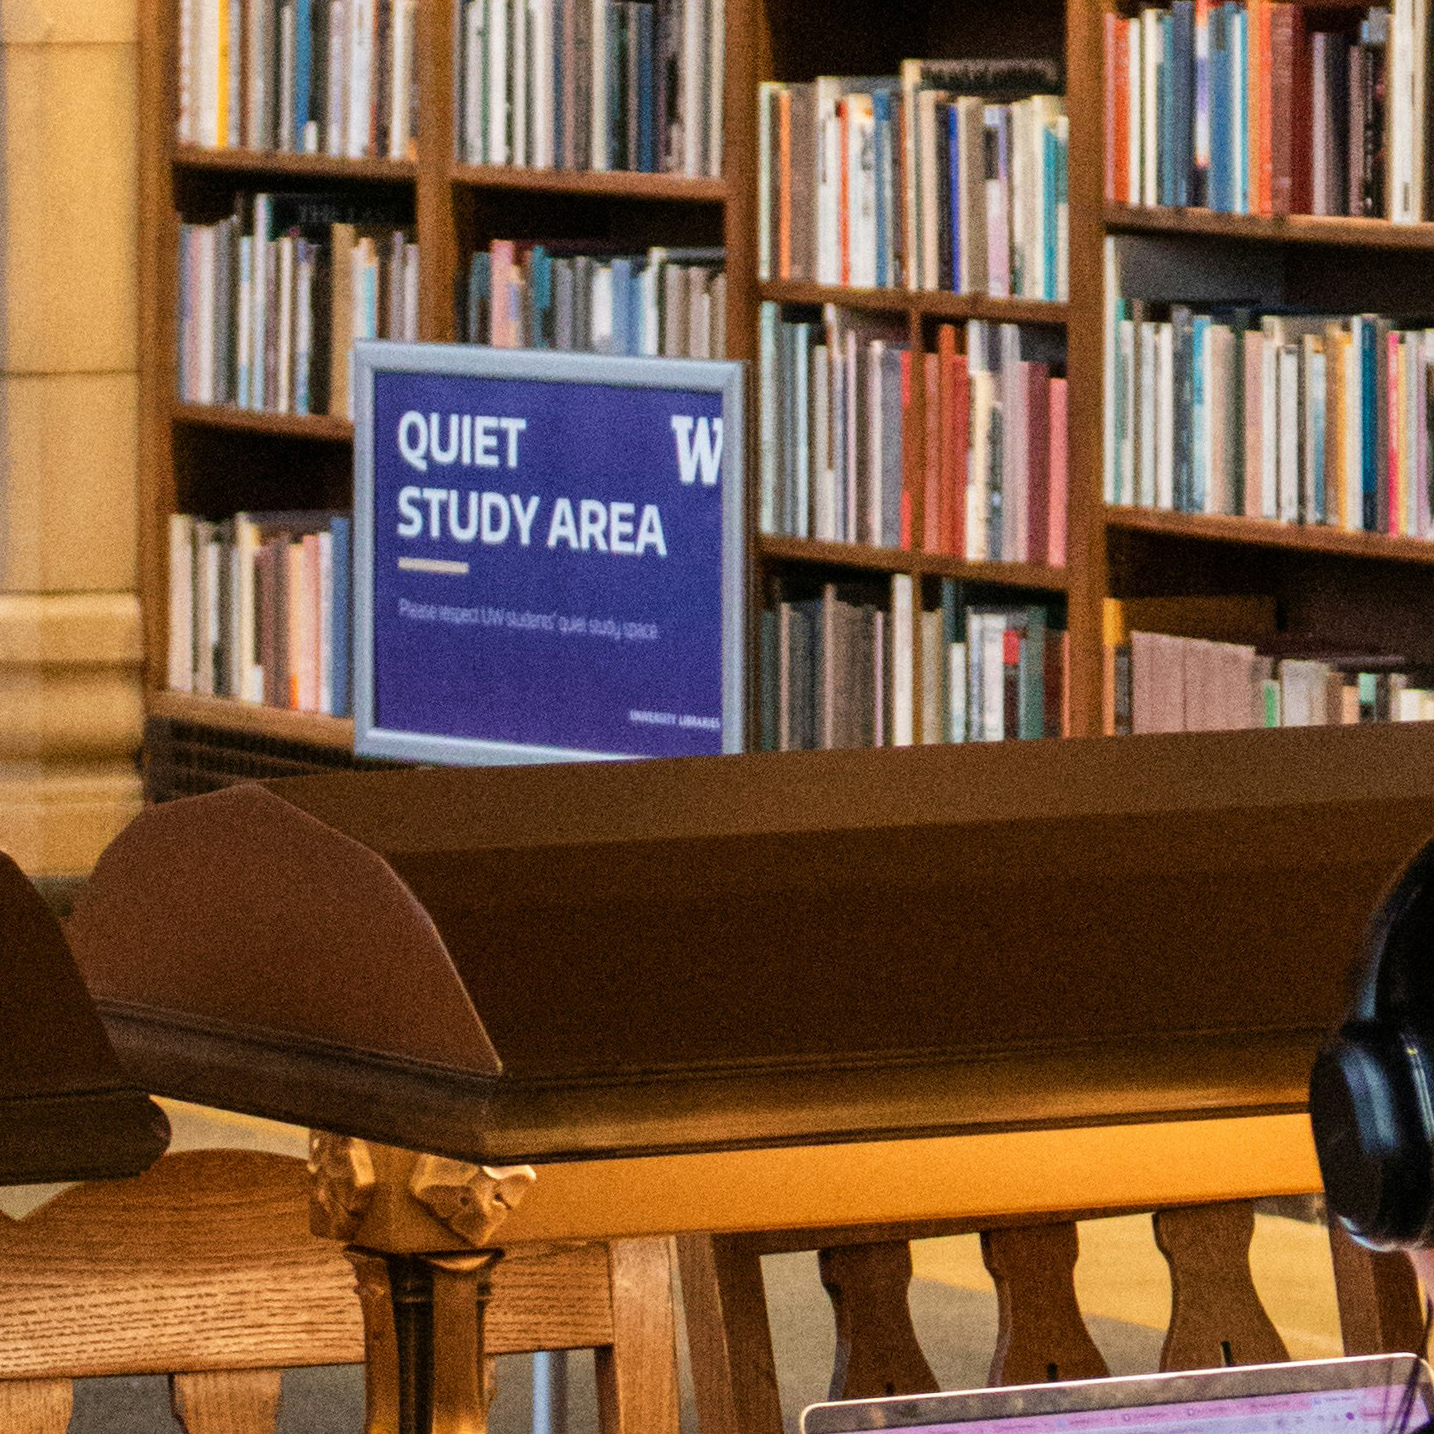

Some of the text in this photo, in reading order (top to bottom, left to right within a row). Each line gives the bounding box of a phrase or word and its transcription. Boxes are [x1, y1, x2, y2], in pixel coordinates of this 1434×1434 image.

[398, 410, 527, 471] QUIET
[671, 414, 723, 486] W
[398, 485, 667, 557] STUDY AREA
[399, 597, 437, 620] Please
[438, 605, 479, 626] respect
[480, 606, 504, 626] UW
[558, 615, 587, 635] quiet
[588, 617, 621, 641] study
[629, 709, 721, 730] UNIVERSITY LIBRARIES
